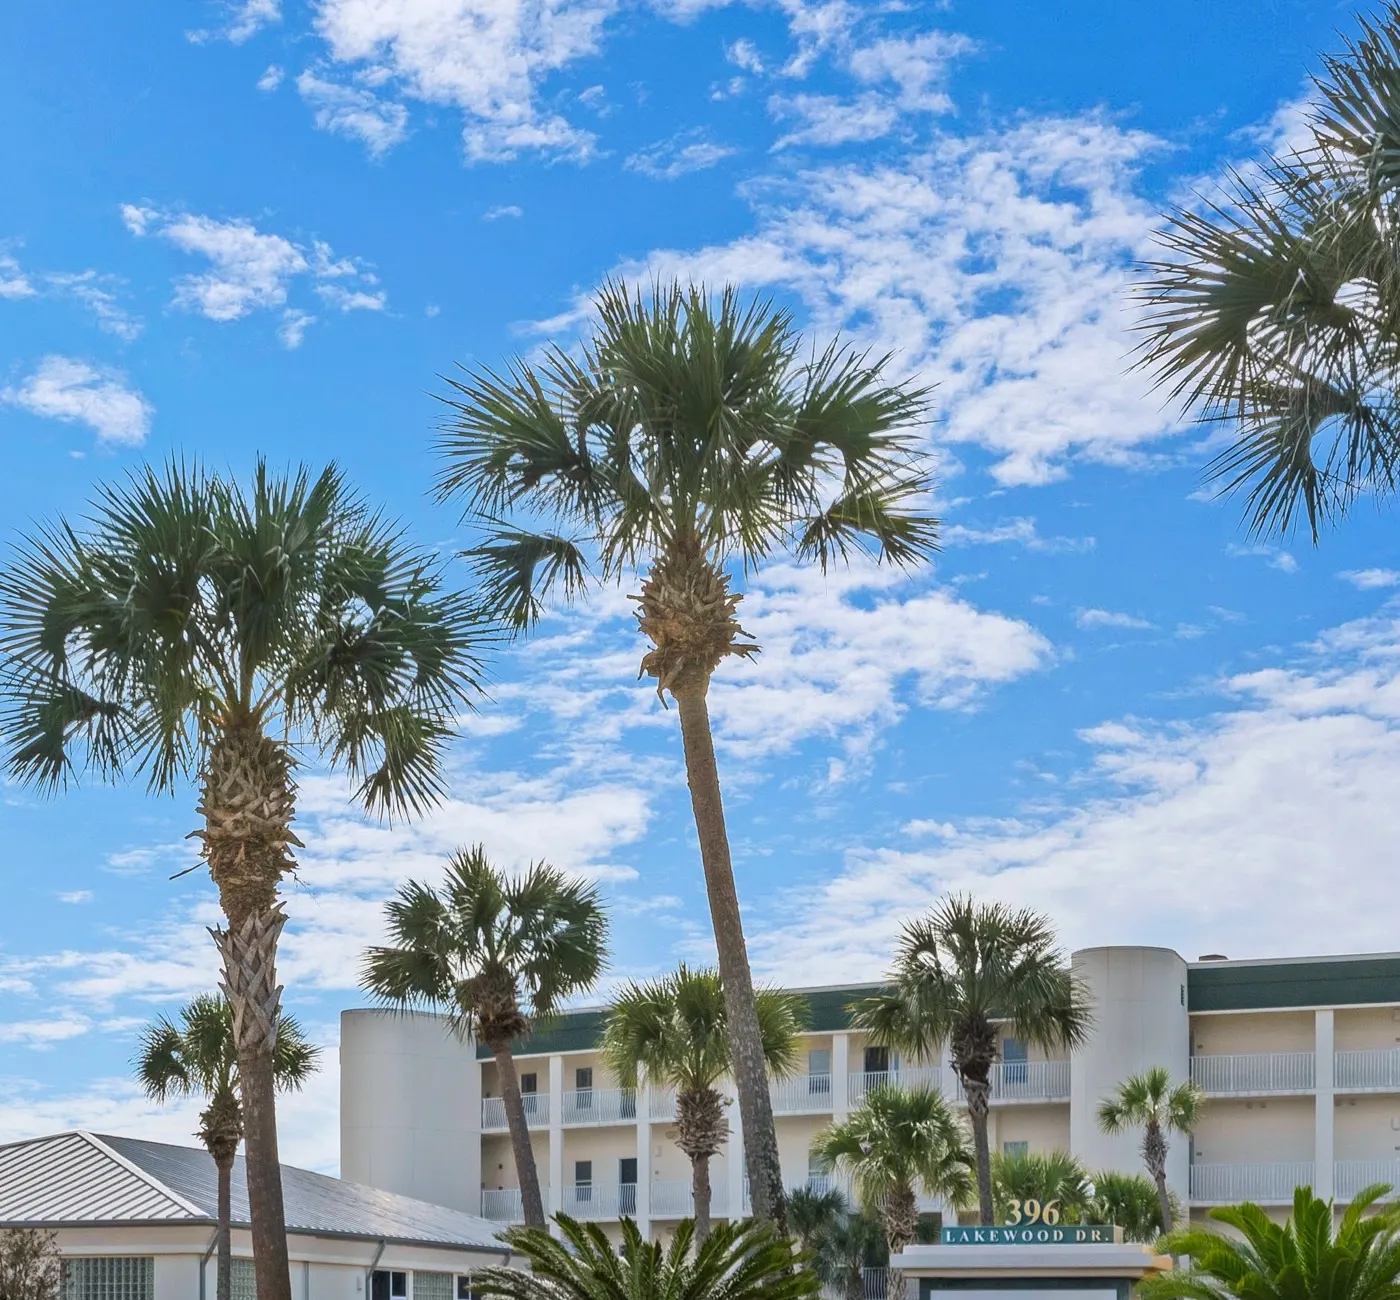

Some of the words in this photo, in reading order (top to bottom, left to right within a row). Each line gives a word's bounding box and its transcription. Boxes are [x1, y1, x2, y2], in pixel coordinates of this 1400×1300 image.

[1004, 1199, 1060, 1227] 396
[945, 1229, 1064, 1243] LAKEWOOD
[1075, 1229, 1110, 1242] DR.
